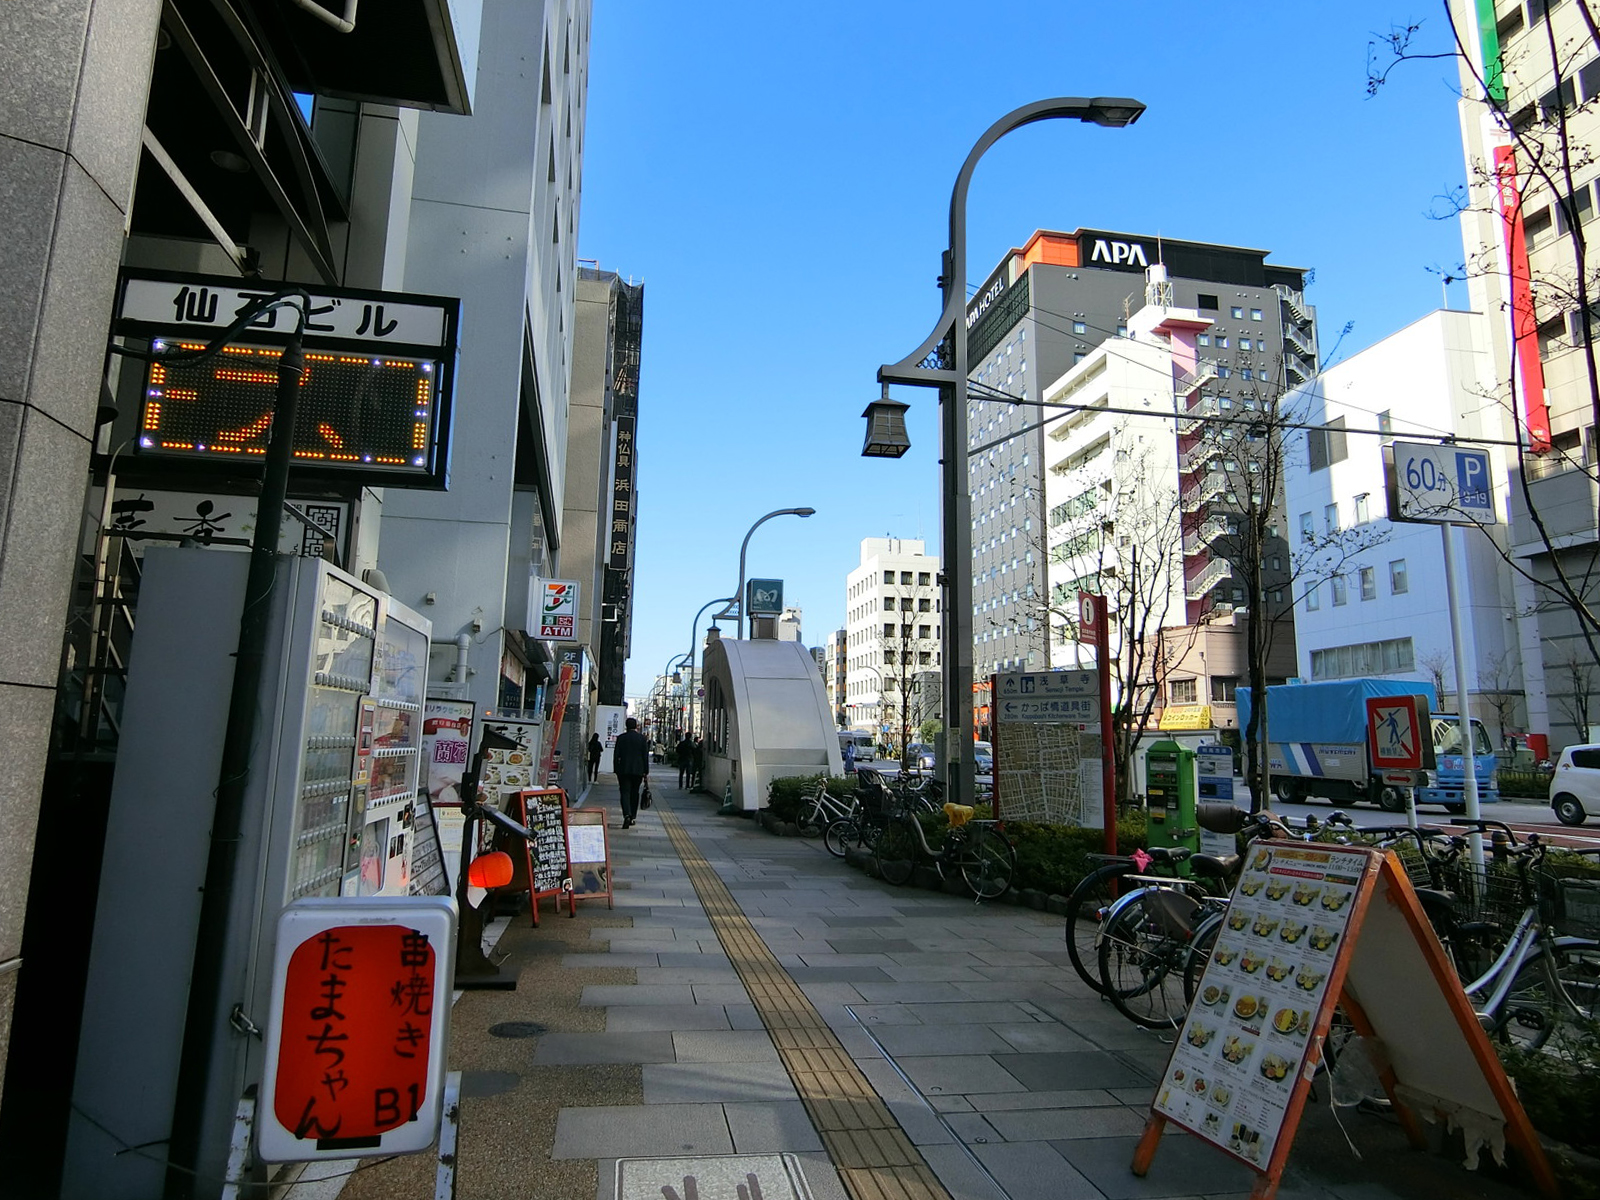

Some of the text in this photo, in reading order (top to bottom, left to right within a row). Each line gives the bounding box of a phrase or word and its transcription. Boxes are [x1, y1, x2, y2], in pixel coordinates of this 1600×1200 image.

[1091, 239, 1148, 267] APA
[173, 286, 398, 337] 仙石ビル
[979, 277, 1004, 315] HOTEL
[1464, 457, 1481, 487] P
[611, 431, 632, 555] 神仏具 浜田商店
[544, 627, 571, 636] ATM
[564, 652, 577, 661] 2F
[1040, 674, 1090, 686] 浅草寺
[1021, 701, 1091, 712] かっぱ橋道具街
[390, 930, 431, 1058] 串焼き
[294, 932, 353, 1140] たまちゃん
[374, 1083, 419, 1127] B1
